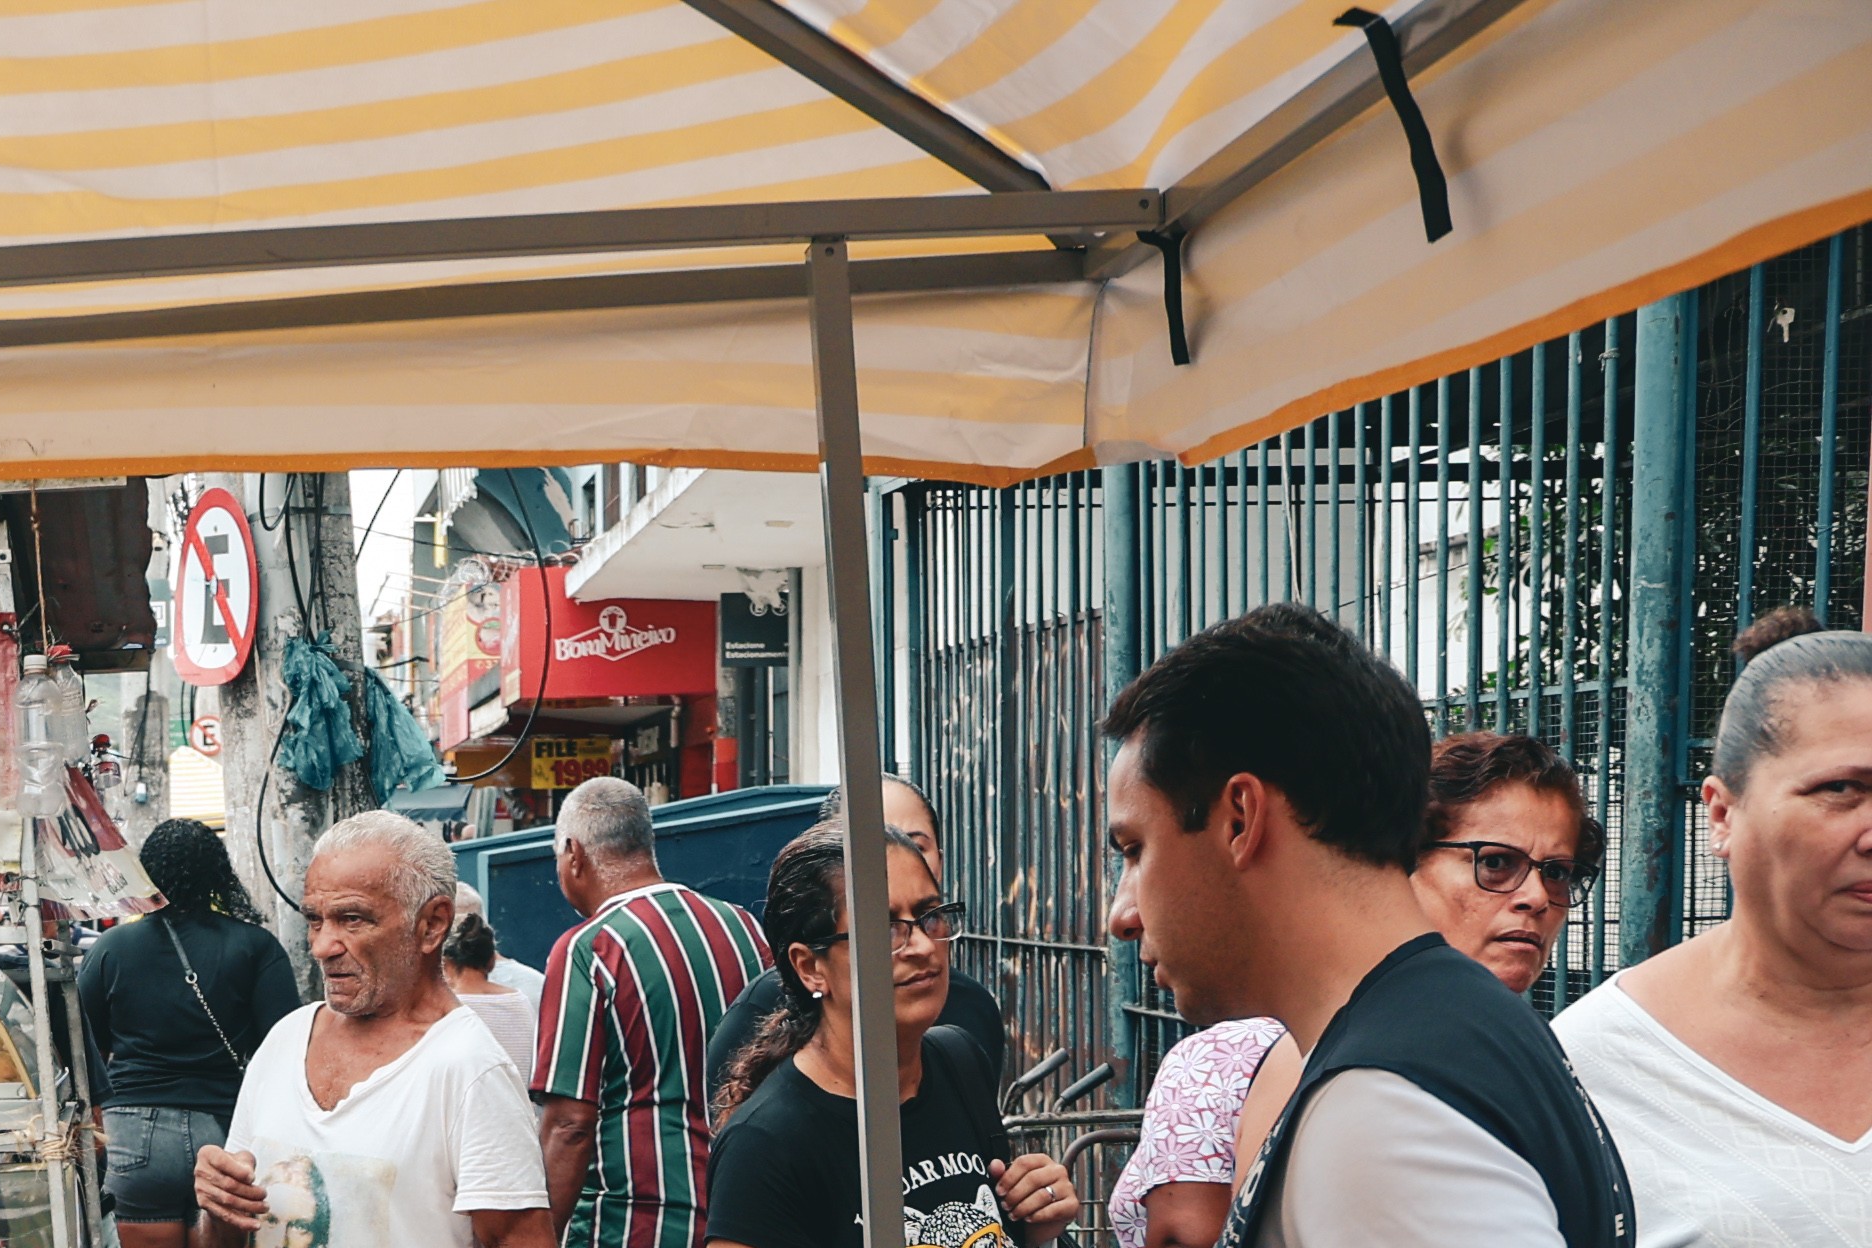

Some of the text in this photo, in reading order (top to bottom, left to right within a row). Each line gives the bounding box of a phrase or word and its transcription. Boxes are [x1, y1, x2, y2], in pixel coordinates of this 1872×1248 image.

[201, 534, 230, 644] E
[203, 723, 215, 747] E
[938, 1152, 990, 1179] MOO
